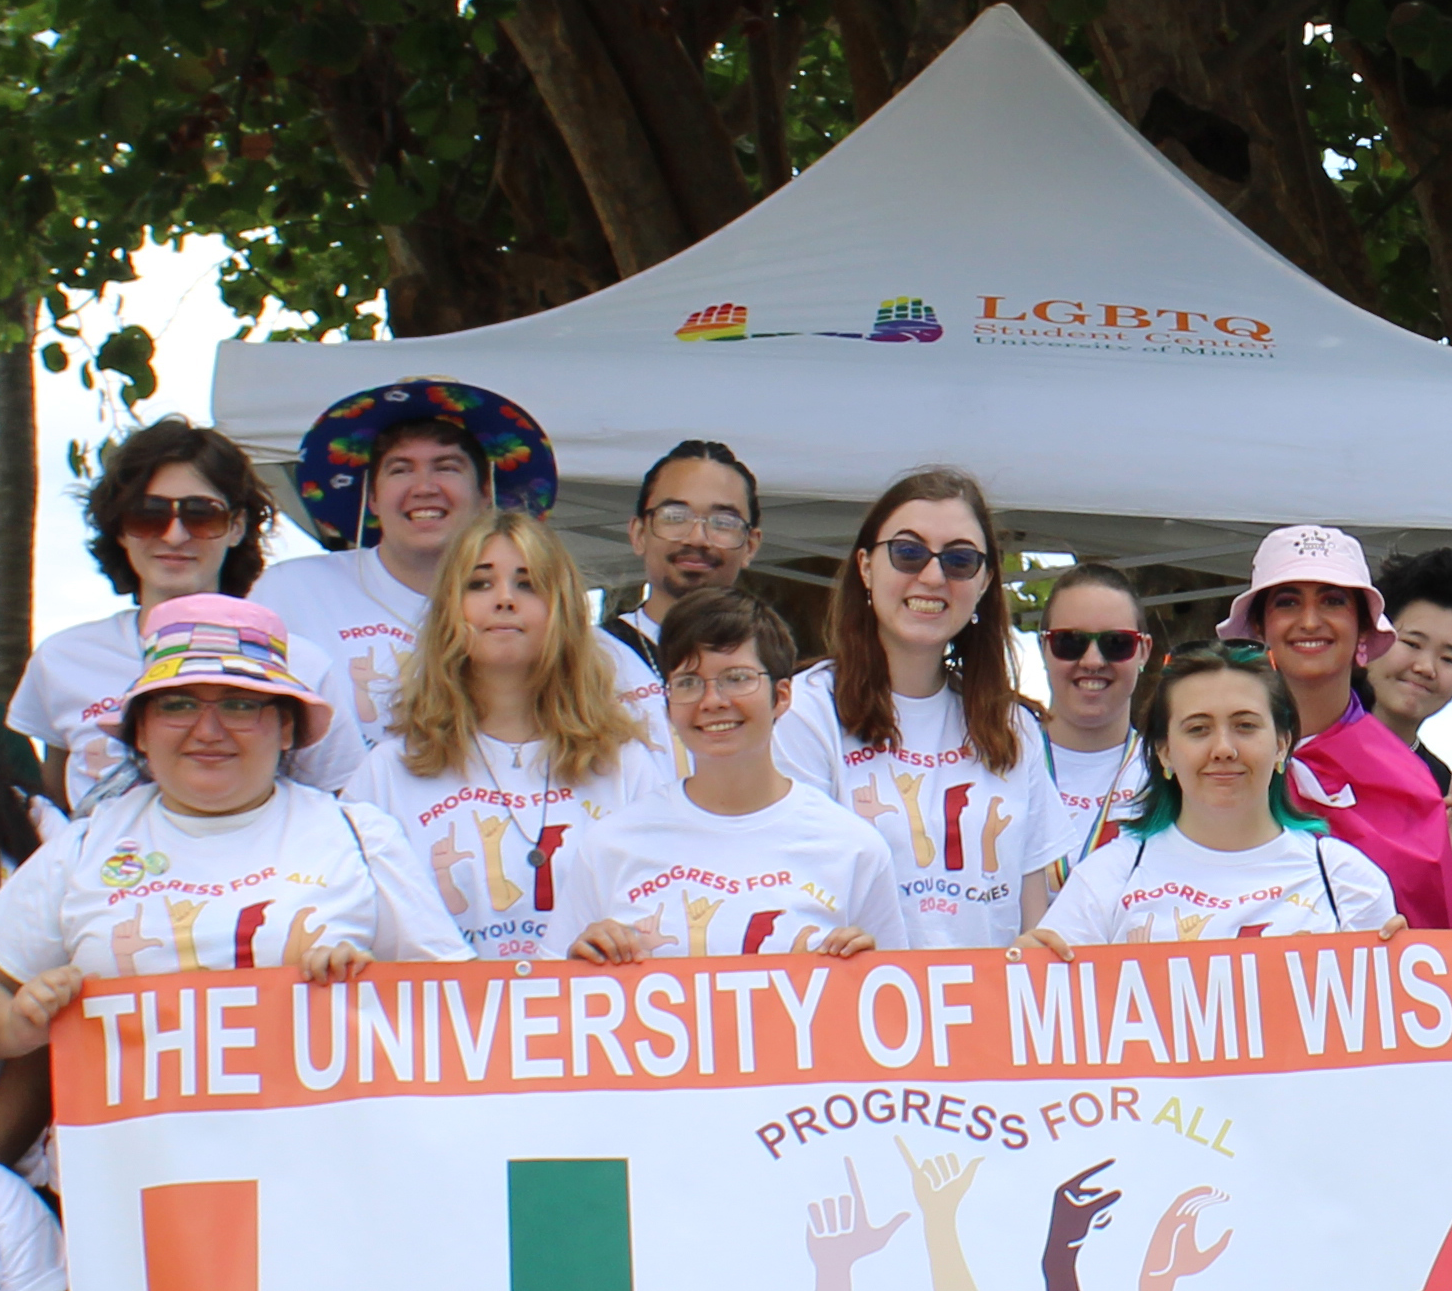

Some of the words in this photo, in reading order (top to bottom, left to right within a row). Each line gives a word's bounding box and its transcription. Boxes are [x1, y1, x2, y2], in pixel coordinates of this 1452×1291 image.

[975, 295, 1274, 342] LGBTQ
[972, 323, 1130, 341] Student
[1145, 332, 1276, 350] Center
[973, 337, 1132, 351] University
[1142, 345, 1170, 353] of
[1181, 347, 1275, 358] Miami
[419, 787, 527, 828] PROGRESS
[531, 787, 574, 808] FOR
[230, 867, 277, 892] FOR
[287, 872, 328, 889] ALL
[628, 864, 740, 904] PROGRESS
[747, 870, 792, 892] FOR
[800, 882, 838, 912] ALL
[900, 878, 935, 897] YOU
[936, 878, 961, 896] GO
[919, 897, 958, 915] 2024
[1122, 881, 1234, 909] PROGRESS
[1238, 885, 1283, 905] FOR
[477, 921, 517, 941] YOU
[84, 986, 260, 1106] THE
[292, 967, 829, 1091] UNIVERSITY
[857, 965, 974, 1068] OF
[1005, 953, 1264, 1067] MIAMI
[756, 1088, 1029, 1159] PROGRESS
[1039, 1086, 1141, 1141] FOR
[1152, 1096, 1237, 1159] ALL
